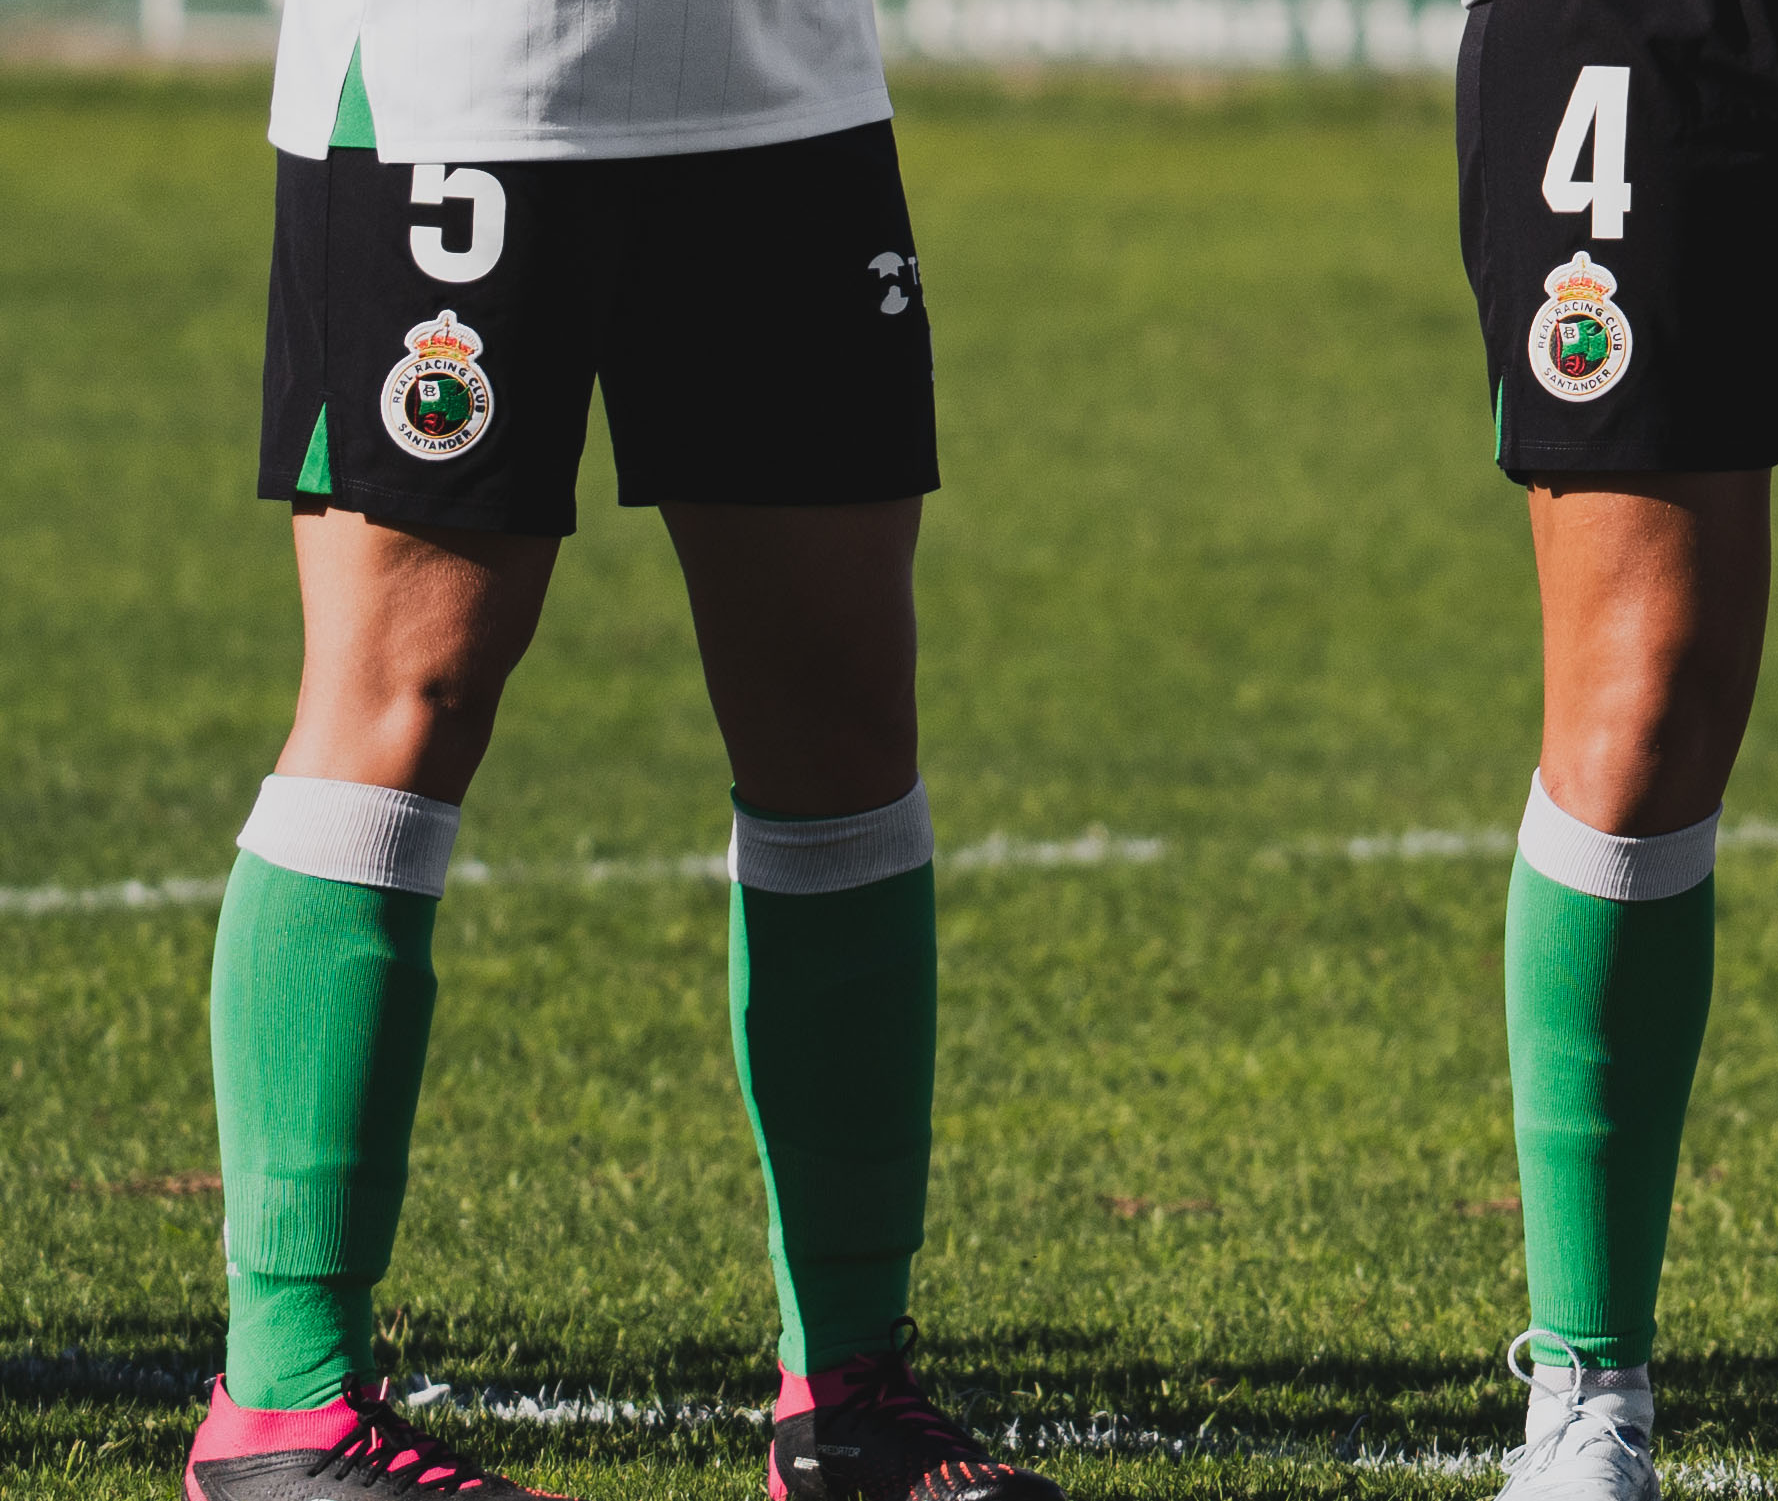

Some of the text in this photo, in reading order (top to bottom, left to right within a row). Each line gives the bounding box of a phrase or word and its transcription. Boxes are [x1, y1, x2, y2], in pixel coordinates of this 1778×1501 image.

[1541, 65, 1632, 240] 4
[410, 163, 507, 284] 5
[1537, 301, 1623, 352] REAL RACING CLUB
[392, 359, 486, 414] REAL RACING CLUB
[1543, 366, 1612, 392] SANTANDER
[398, 422, 473, 451] SANTANDER
